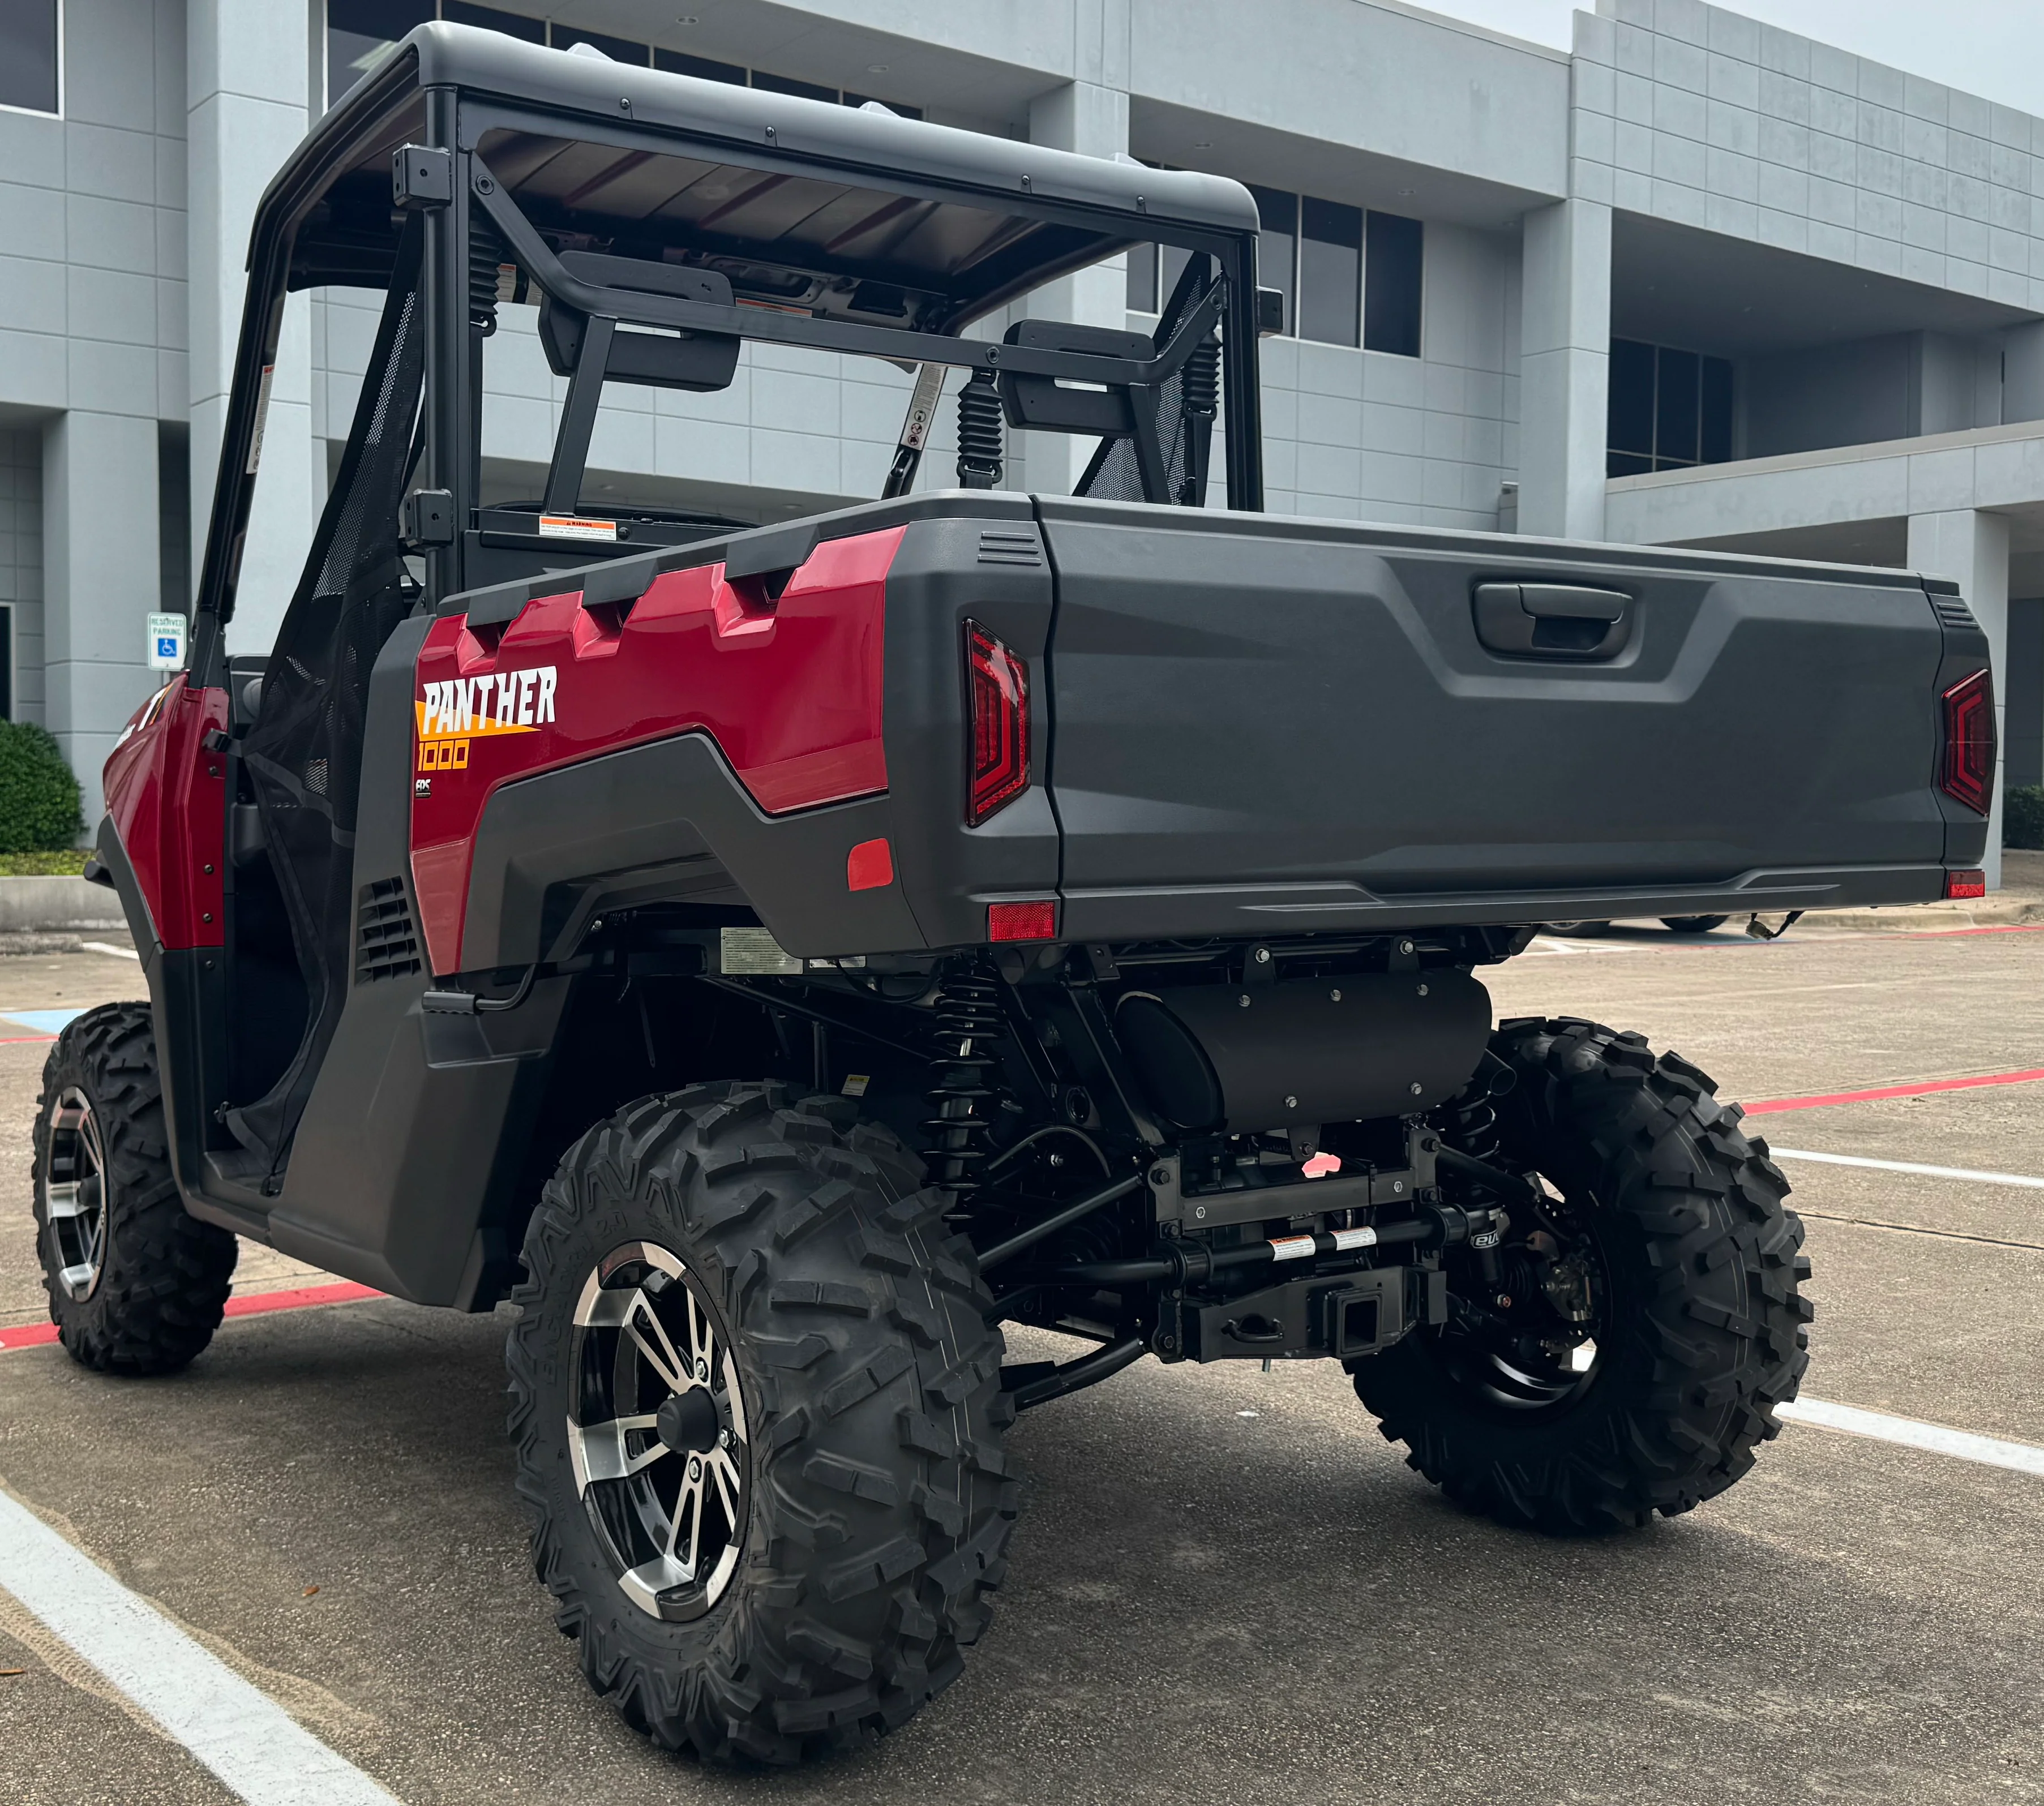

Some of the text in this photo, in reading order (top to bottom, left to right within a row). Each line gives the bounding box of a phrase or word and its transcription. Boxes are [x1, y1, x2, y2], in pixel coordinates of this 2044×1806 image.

[151, 617, 184, 627] RESERVED
[153, 627, 182, 636] PARKING
[423, 666, 558, 735] PANTHER
[417, 739, 470, 771] 1000
